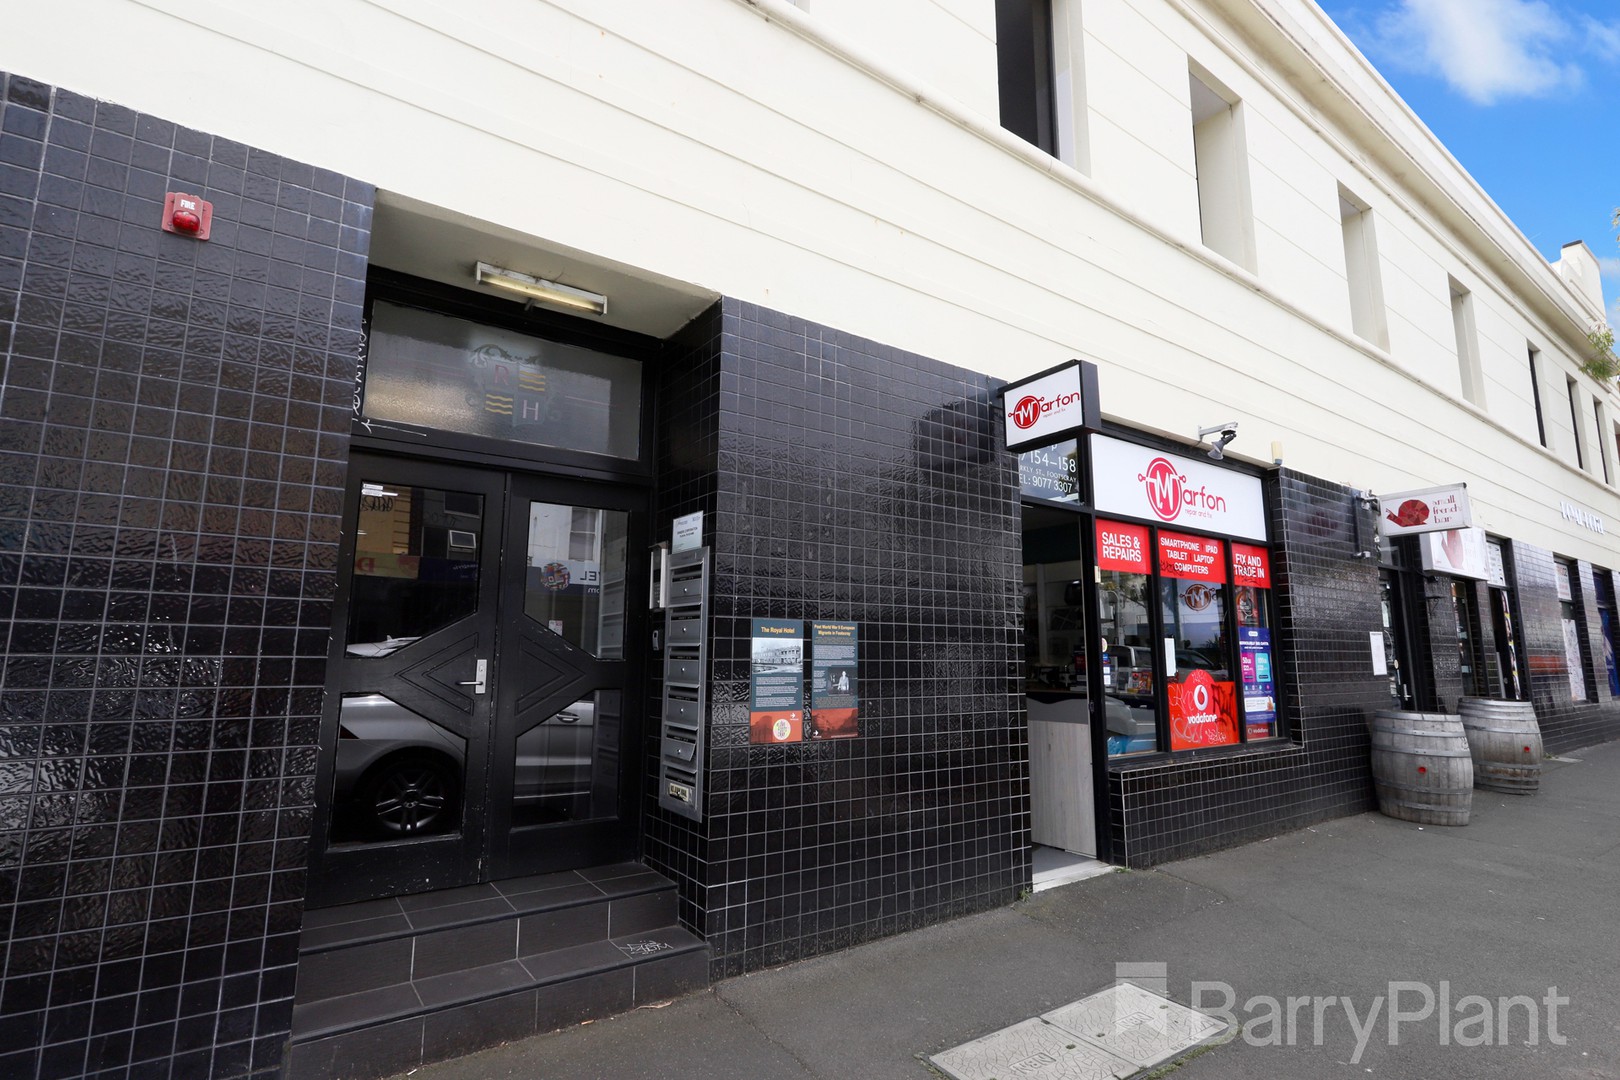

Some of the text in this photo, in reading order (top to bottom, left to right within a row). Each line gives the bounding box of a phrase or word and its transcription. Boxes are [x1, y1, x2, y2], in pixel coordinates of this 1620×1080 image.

[181, 199, 195, 210] FIRE
[522, 400, 539, 421] H
[1013, 393, 1080, 427] Marfon
[1032, 475, 1052, 489] 9077
[1053, 480, 1073, 493] 3307
[1145, 463, 1227, 515] Marfon
[1102, 532, 1140, 550] SALES &
[1160, 537, 1218, 555] SMARTPHONE IPAD
[1103, 545, 1142, 562] REPAIRS
[1166, 549, 1214, 565] TABLET LAPTOP
[1235, 553, 1262, 567] FIX AND
[1174, 562, 1209, 575] COMPUTERS
[1233, 564, 1265, 578] TRADE IN
[1187, 712, 1217, 724] vodafone
